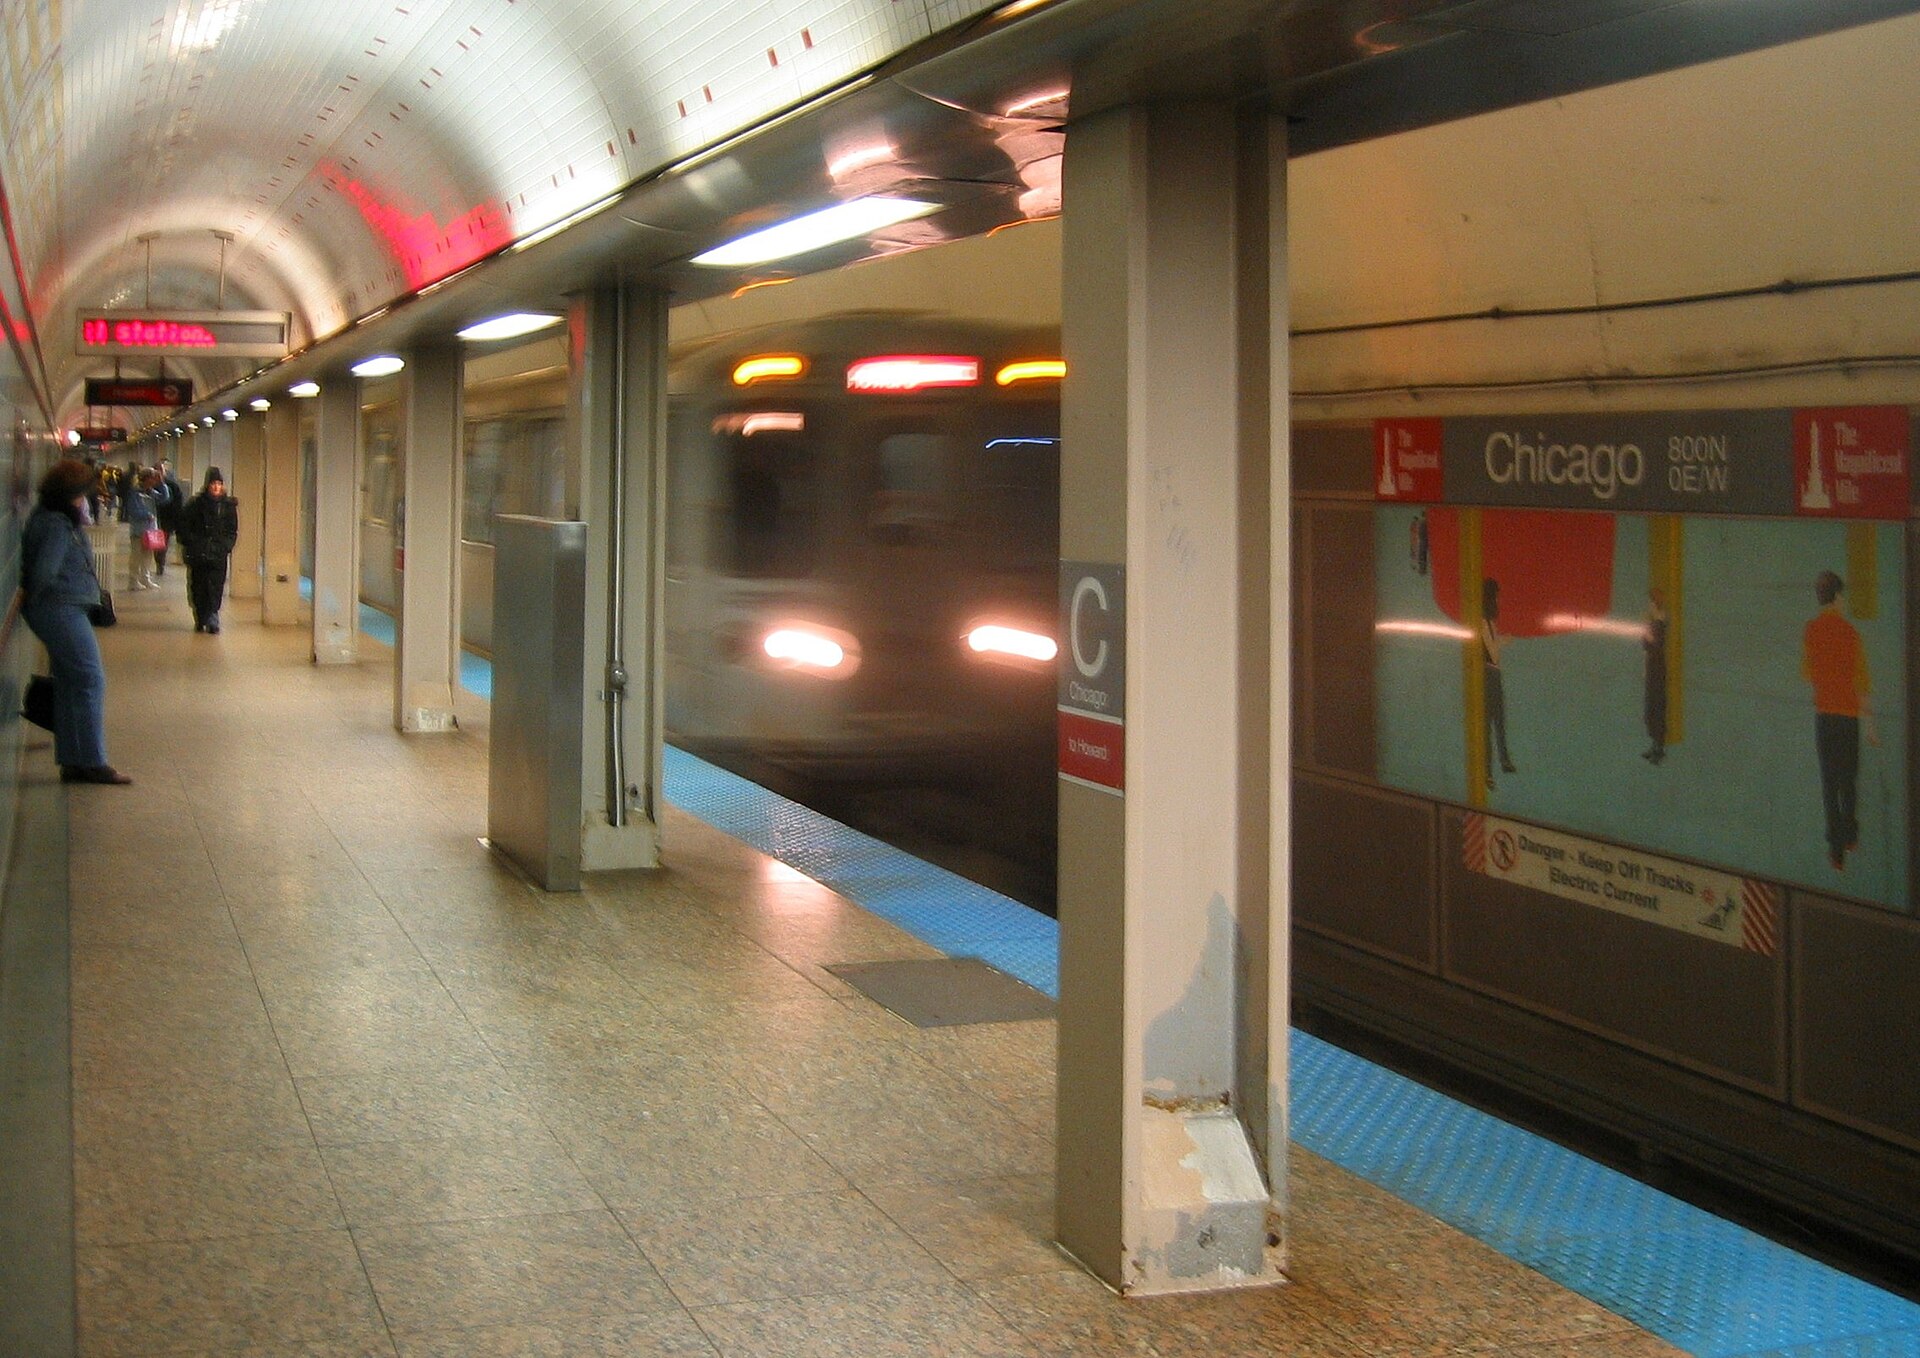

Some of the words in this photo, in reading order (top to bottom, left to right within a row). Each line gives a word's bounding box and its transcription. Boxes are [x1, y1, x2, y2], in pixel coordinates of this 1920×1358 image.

[1484, 431, 1645, 499] Chicago
[1667, 435, 1727, 462] 800N
[1070, 576, 1108, 678] C
[1069, 681, 1108, 709] Chicago
[1517, 834, 1564, 861] Danger
[1578, 849, 1613, 875] Keep
[1618, 860, 1641, 881] Off
[1644, 866, 1695, 895] Tracks
[1549, 865, 1600, 895] Electric
[1603, 881, 1659, 911] Current
